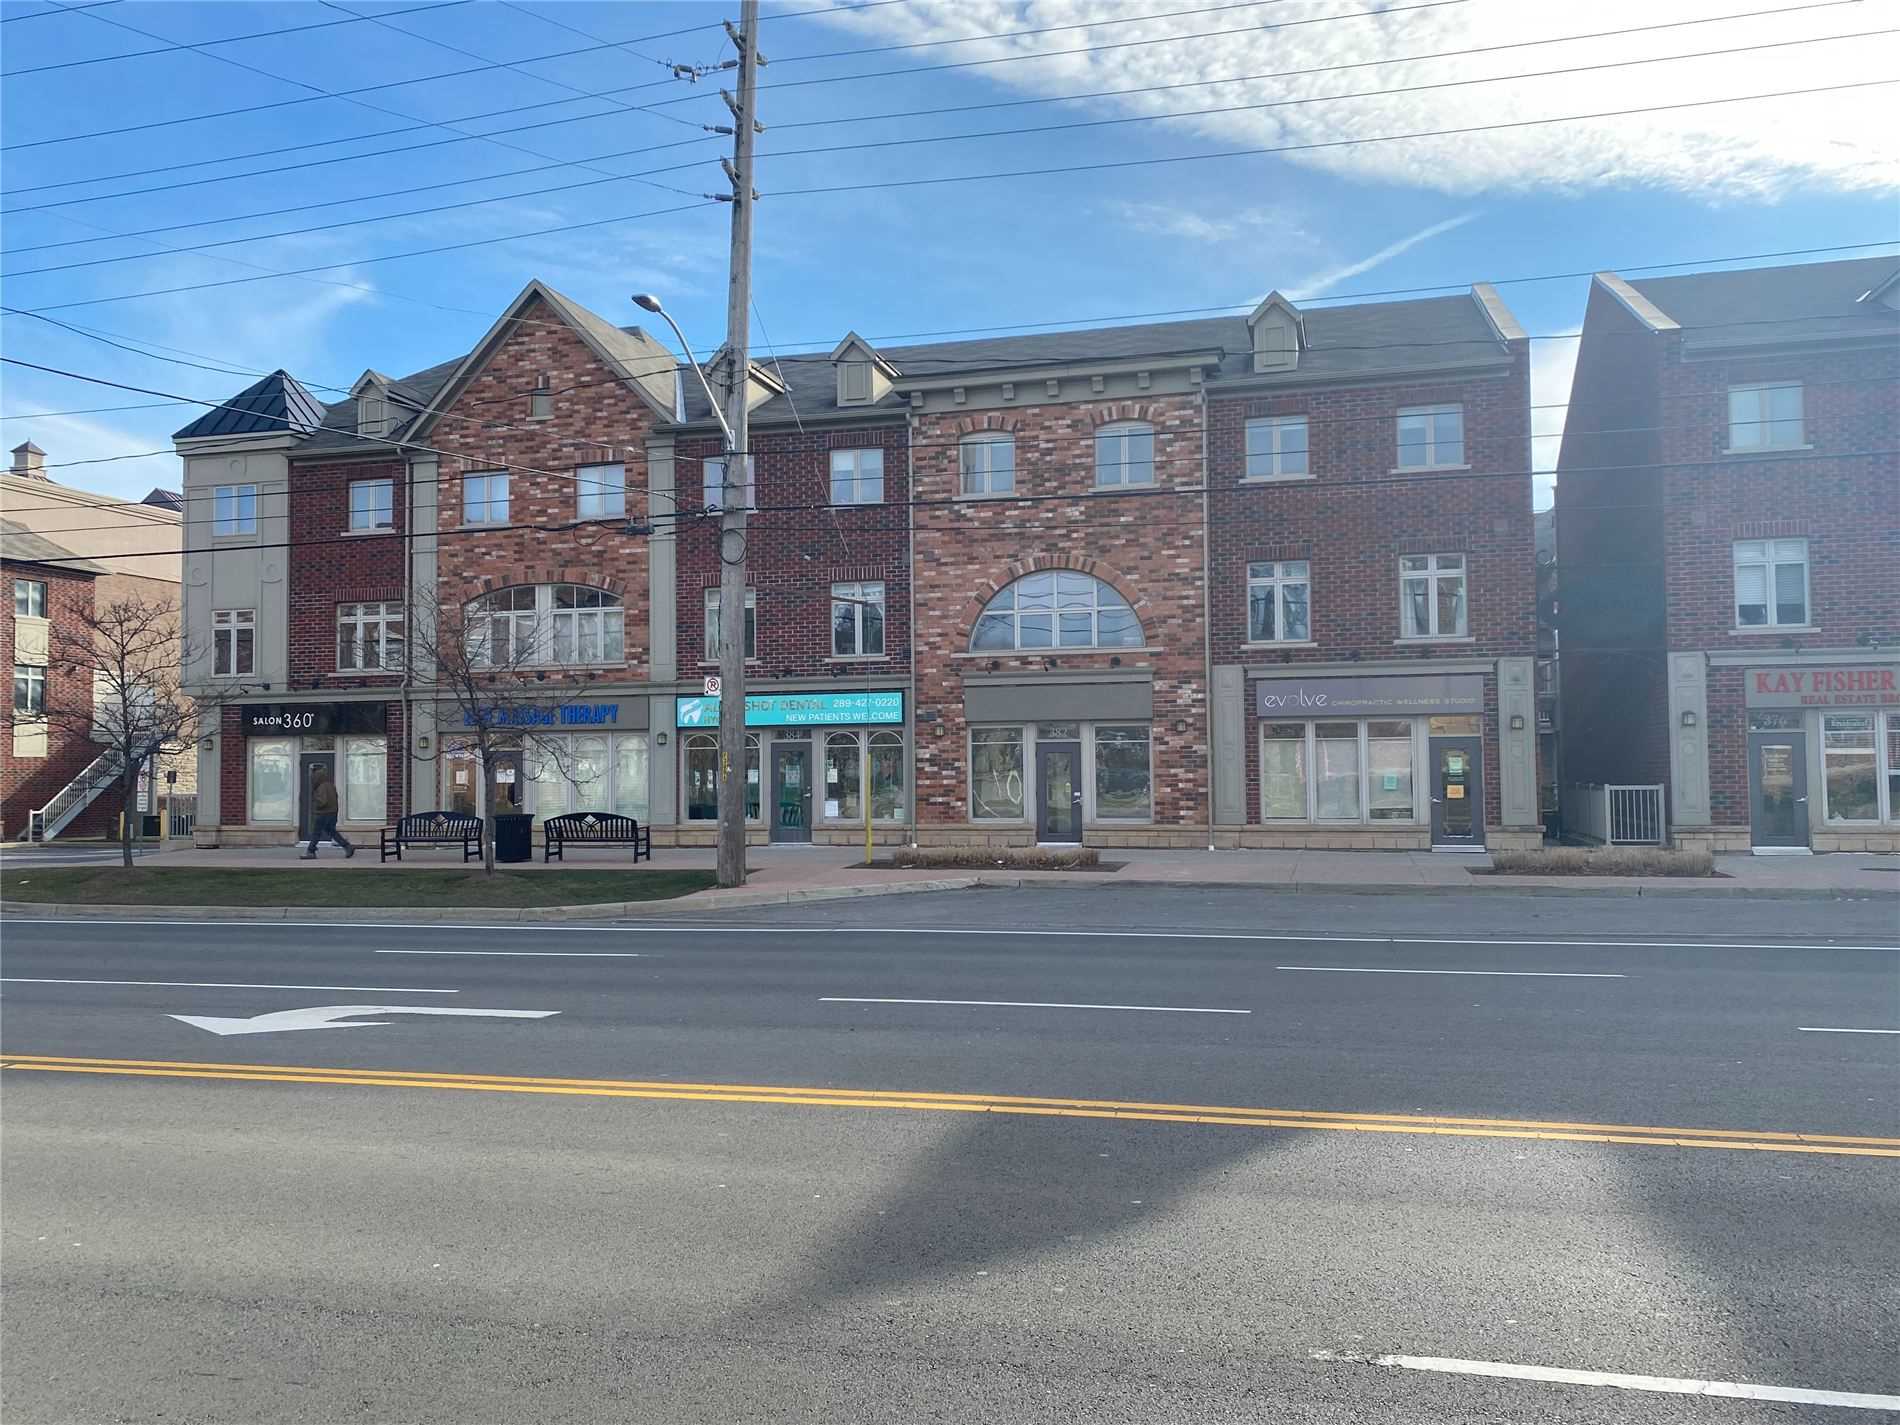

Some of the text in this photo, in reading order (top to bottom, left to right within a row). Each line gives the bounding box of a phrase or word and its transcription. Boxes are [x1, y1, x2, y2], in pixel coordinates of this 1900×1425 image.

[1755, 671, 1896, 693] KAY FISHER
[780, 699, 825, 711] DENTAL
[1264, 688, 1328, 708] evolve
[252, 717, 282, 725] SALON
[560, 704, 618, 724] THERAPY
[785, 713, 806, 721] NEW
[808, 711, 850, 720] PATIENTS
